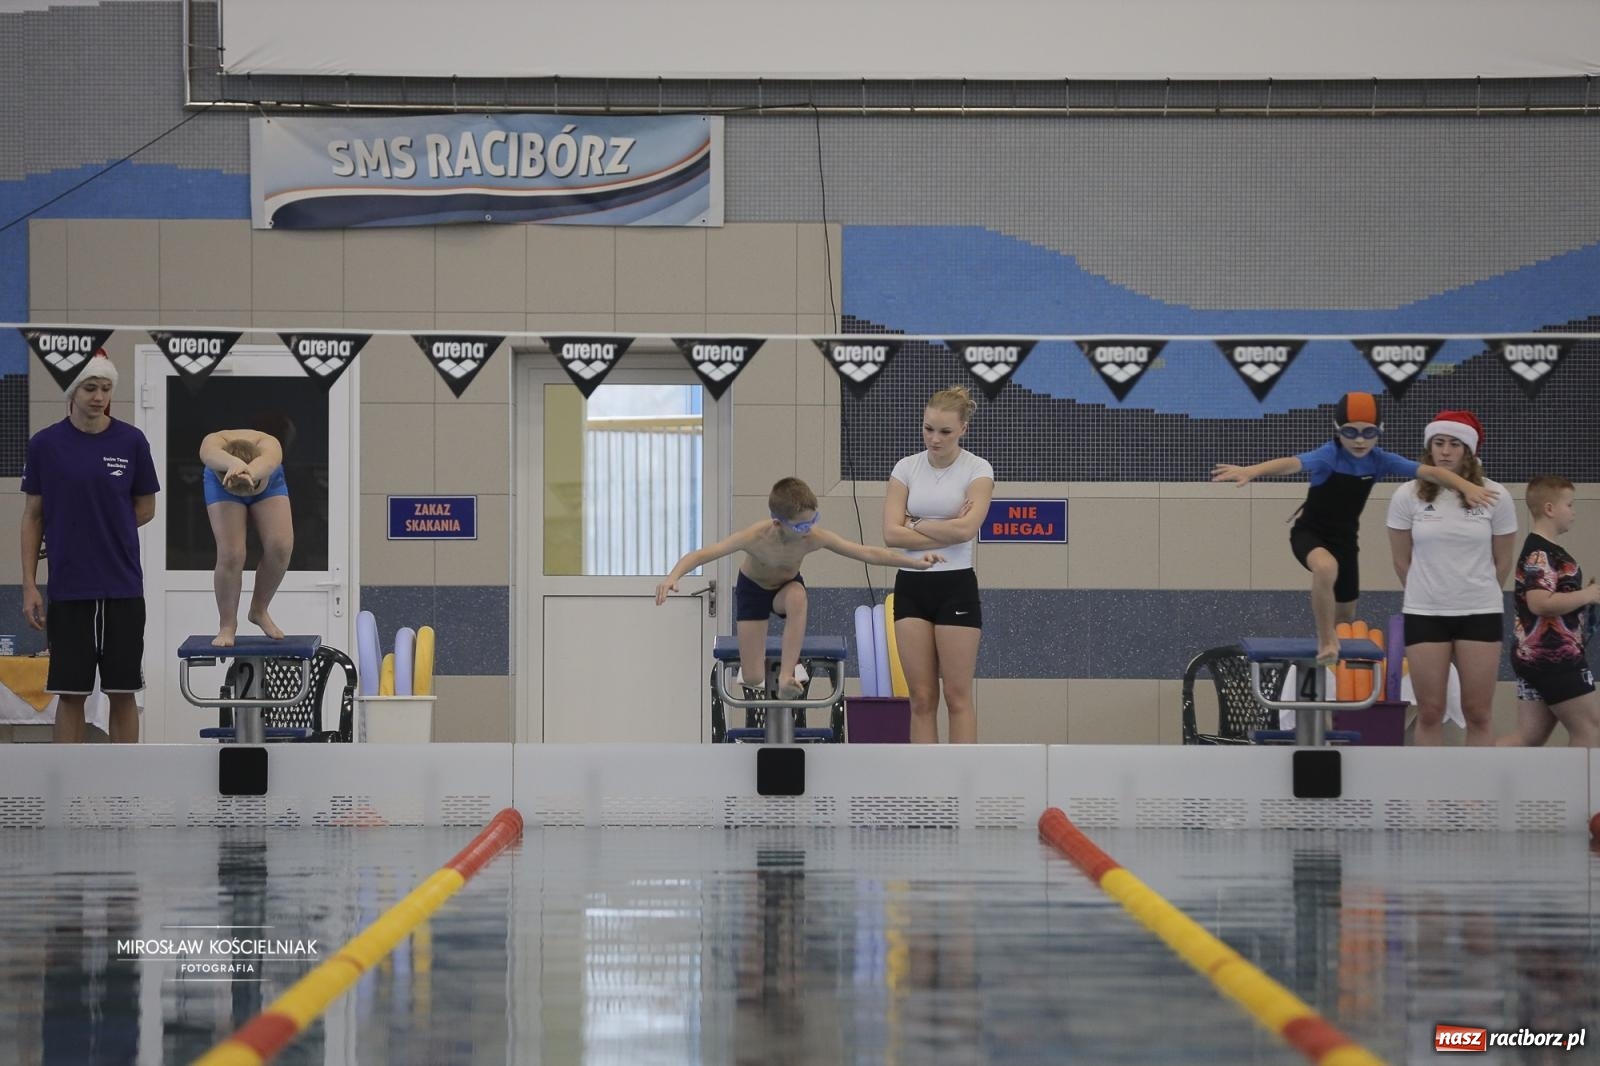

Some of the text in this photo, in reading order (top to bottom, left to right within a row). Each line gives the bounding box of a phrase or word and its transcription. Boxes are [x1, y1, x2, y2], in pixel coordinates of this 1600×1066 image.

[327, 124, 636, 179] SMS RACIBÓRZ
[39, 334, 92, 351] arena
[168, 336, 221, 354] arena
[299, 338, 351, 356] arena
[432, 341, 485, 359] arena
[562, 342, 615, 360] arena
[692, 343, 744, 361] arena
[833, 344, 886, 362] arena
[965, 345, 1018, 363] arena
[1095, 345, 1148, 363] arena
[1234, 345, 1287, 362] arena
[1372, 344, 1426, 362] arena
[1504, 343, 1558, 361] arena
[414, 503, 451, 516] ZAKAZ
[1008, 506, 1037, 519] NIE
[405, 519, 461, 532] SKAKANIA
[992, 523, 1054, 536] BIEGAJ
[1300, 667, 1318, 700] 4
